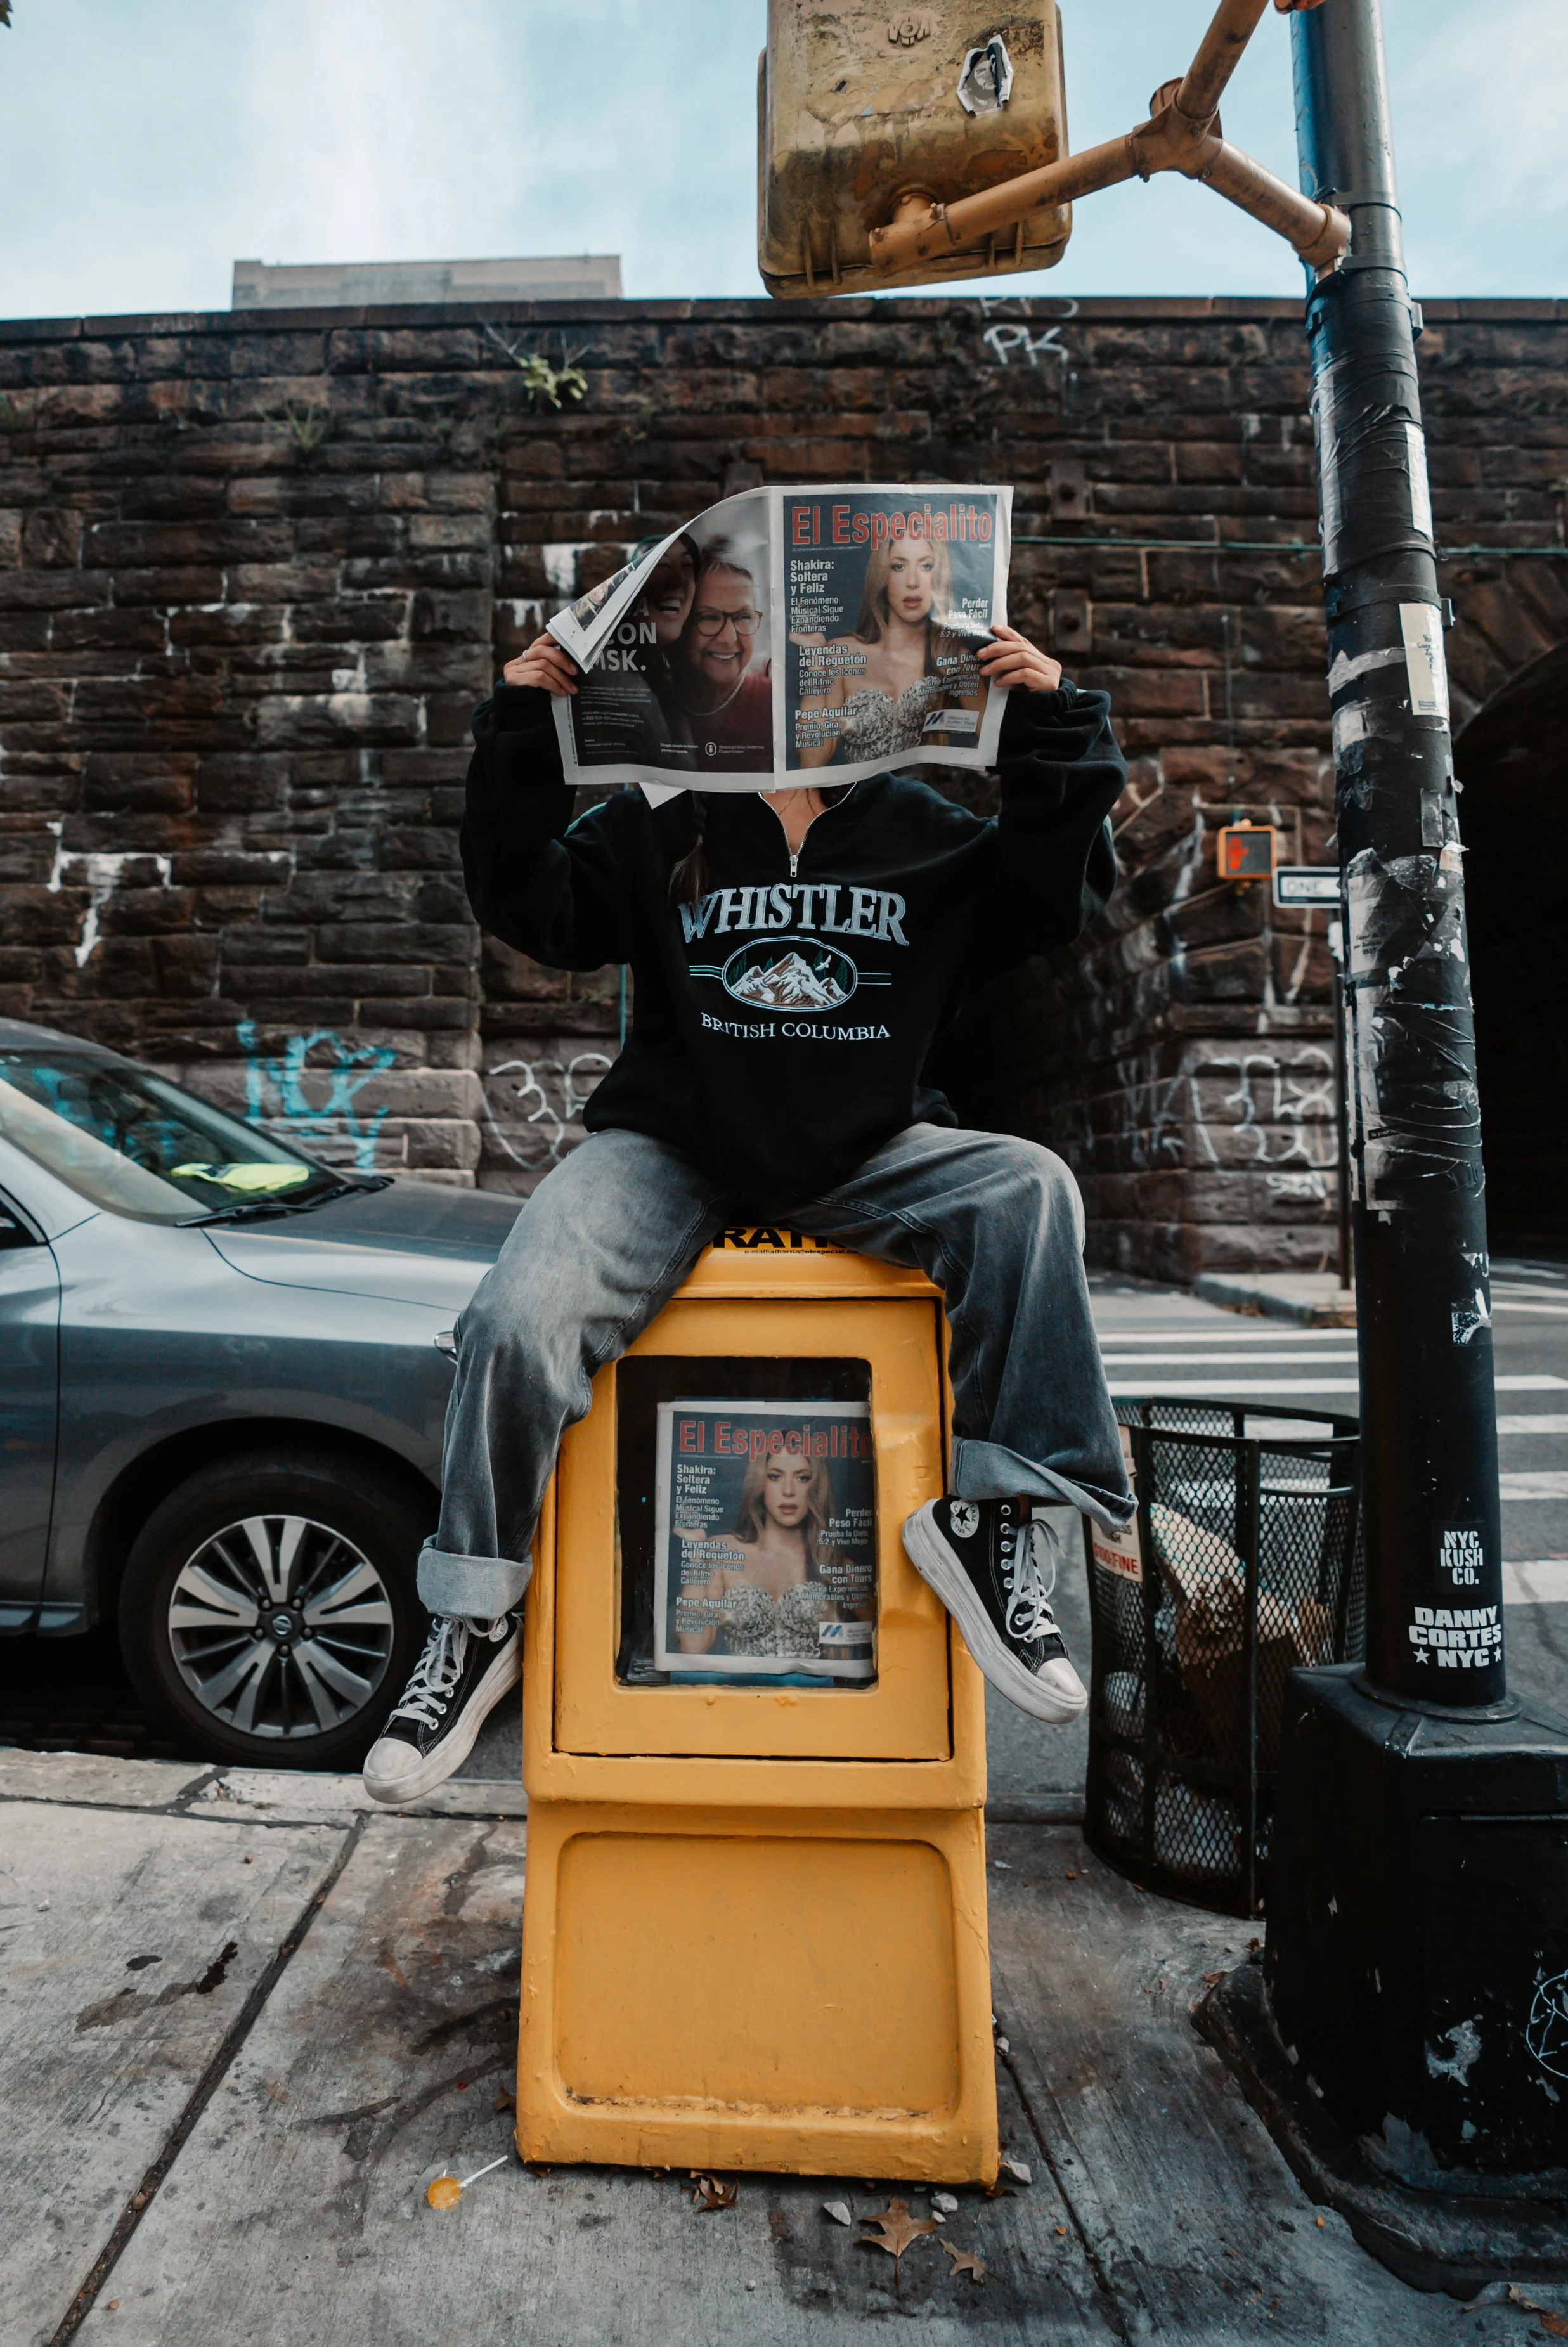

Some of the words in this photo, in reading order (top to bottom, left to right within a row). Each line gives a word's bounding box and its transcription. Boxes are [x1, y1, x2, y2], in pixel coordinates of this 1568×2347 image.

[792, 506, 820, 545] El
[833, 503, 992, 551] Especialito
[790, 560, 834, 571] Shakira:
[790, 571, 828, 583] Soltera
[791, 586, 796, 596] y
[800, 583, 824, 593] Feliz
[791, 597, 798, 606] El
[800, 596, 839, 605] Fenómeno
[962, 598, 988, 609] Perder
[791, 606, 820, 615] Musical
[822, 605, 844, 616] Sigue
[948, 609, 966, 619] Peso
[968, 608, 987, 619] Fácil
[791, 614, 839, 624] Expandiendo
[606, 622, 657, 645] ON
[791, 624, 827, 633] Fronteras
[799, 643, 848, 656] Leyendas
[799, 657, 815, 667] del
[818, 653, 867, 668] Reguetón
[936, 656, 957, 667] Gana
[799, 669, 827, 678] Conoce
[828, 668, 840, 676] los
[841, 668, 866, 676] Iconos
[946, 666, 961, 675] con
[962, 663, 981, 672] Tour
[812, 678, 834, 686] Ritmo
[959, 680, 979, 689] Obtén
[799, 687, 832, 696] Callejero
[949, 689, 978, 697] Ingresos
[794, 709, 819, 720] Pepe
[822, 706, 857, 719] Aguilar
[824, 721, 839, 729] Gira
[801, 730, 841, 739] Revolución
[796, 739, 824, 748] Musical
[1286, 881, 1321, 895] ONE
[677, 883, 910, 947] WHISTLER
[701, 1012, 775, 1038] BRITISH
[781, 1022, 891, 1040] COLUMBIA
[680, 1420, 705, 1452] El
[715, 1421, 873, 1461] Especialito
[677, 1464, 716, 1475] Shakira:
[677, 1474, 710, 1484] Soltera
[676, 1485, 682, 1495] y
[684, 1484, 707, 1494] Feliz
[684, 1496, 720, 1505] Fenómeno
[675, 1504, 703, 1512] Musical
[704, 1505, 723, 1513] Sigue
[845, 1508, 872, 1518] Perder
[675, 1512, 720, 1521] Expandiendo
[675, 1520, 708, 1529] Fronteras
[829, 1518, 851, 1527] Peso
[853, 1518, 872, 1527] Fácil
[820, 1529, 844, 1537] Prueba
[682, 1539, 727, 1549] Leyendas
[1444, 1531, 1479, 1549] NYC
[681, 1549, 696, 1558] del
[699, 1550, 745, 1561] Reguetón
[1440, 1548, 1483, 1567] KUSH
[720, 1562, 744, 1570] Iconos
[819, 1564, 843, 1574] Gana
[845, 1564, 872, 1574] Dinero
[1111, 1552, 1139, 1575] FINE
[680, 1577, 711, 1586] Callejero
[850, 1574, 872, 1582] Tours
[1452, 1567, 1479, 1585] CO.
[676, 1596, 700, 1608] Pepe
[703, 1598, 737, 1609] Aguilar
[801, 1593, 845, 1601] Memorables
[682, 1617, 720, 1626] Revolución
[1415, 1605, 1498, 1627] DANNY
[1409, 1624, 1501, 1648] CORTES
[1437, 1648, 1489, 1668] NYC
